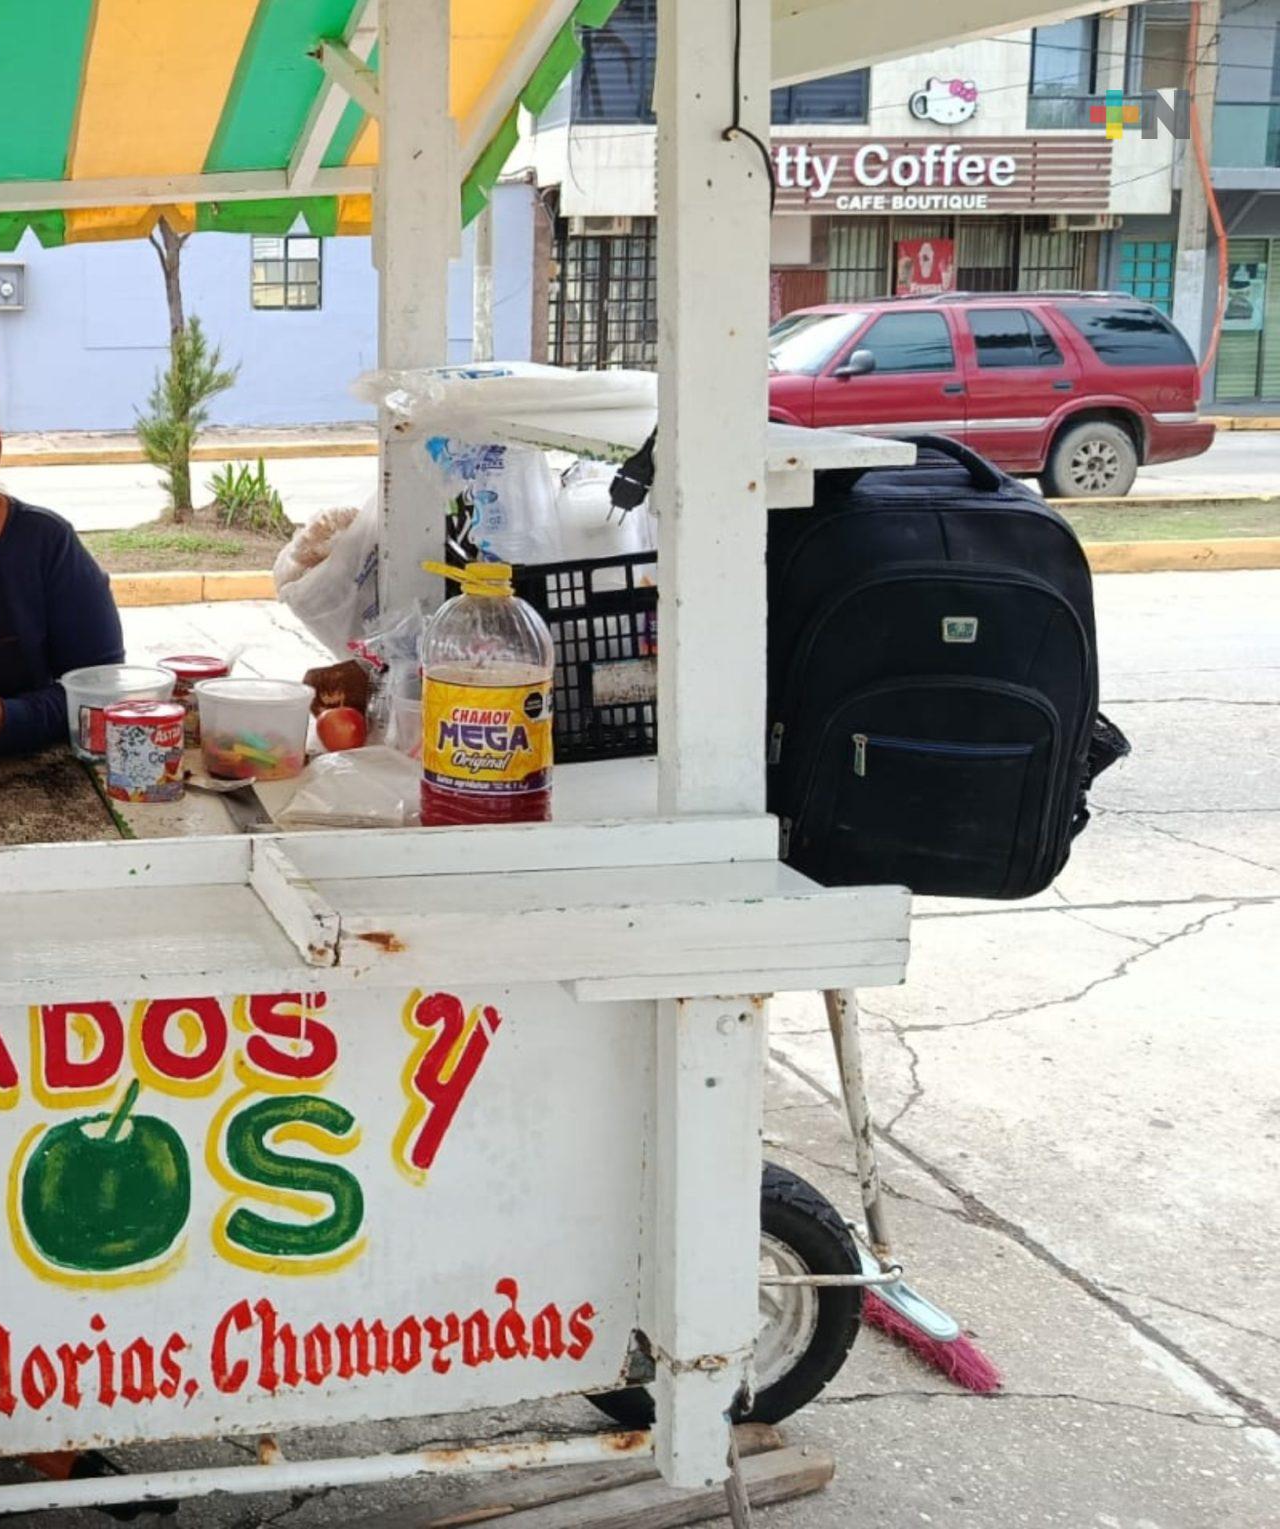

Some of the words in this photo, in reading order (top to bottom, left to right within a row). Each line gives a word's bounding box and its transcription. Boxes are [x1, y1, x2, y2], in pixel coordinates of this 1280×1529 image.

[854, 144, 1017, 187] Coffee
[836, 195, 885, 211] CAFE
[892, 195, 989, 210] BOUTIQUE
[451, 709, 512, 725] CHAMOY
[437, 721, 530, 752] MEGA
[451, 751, 514, 774] Original
